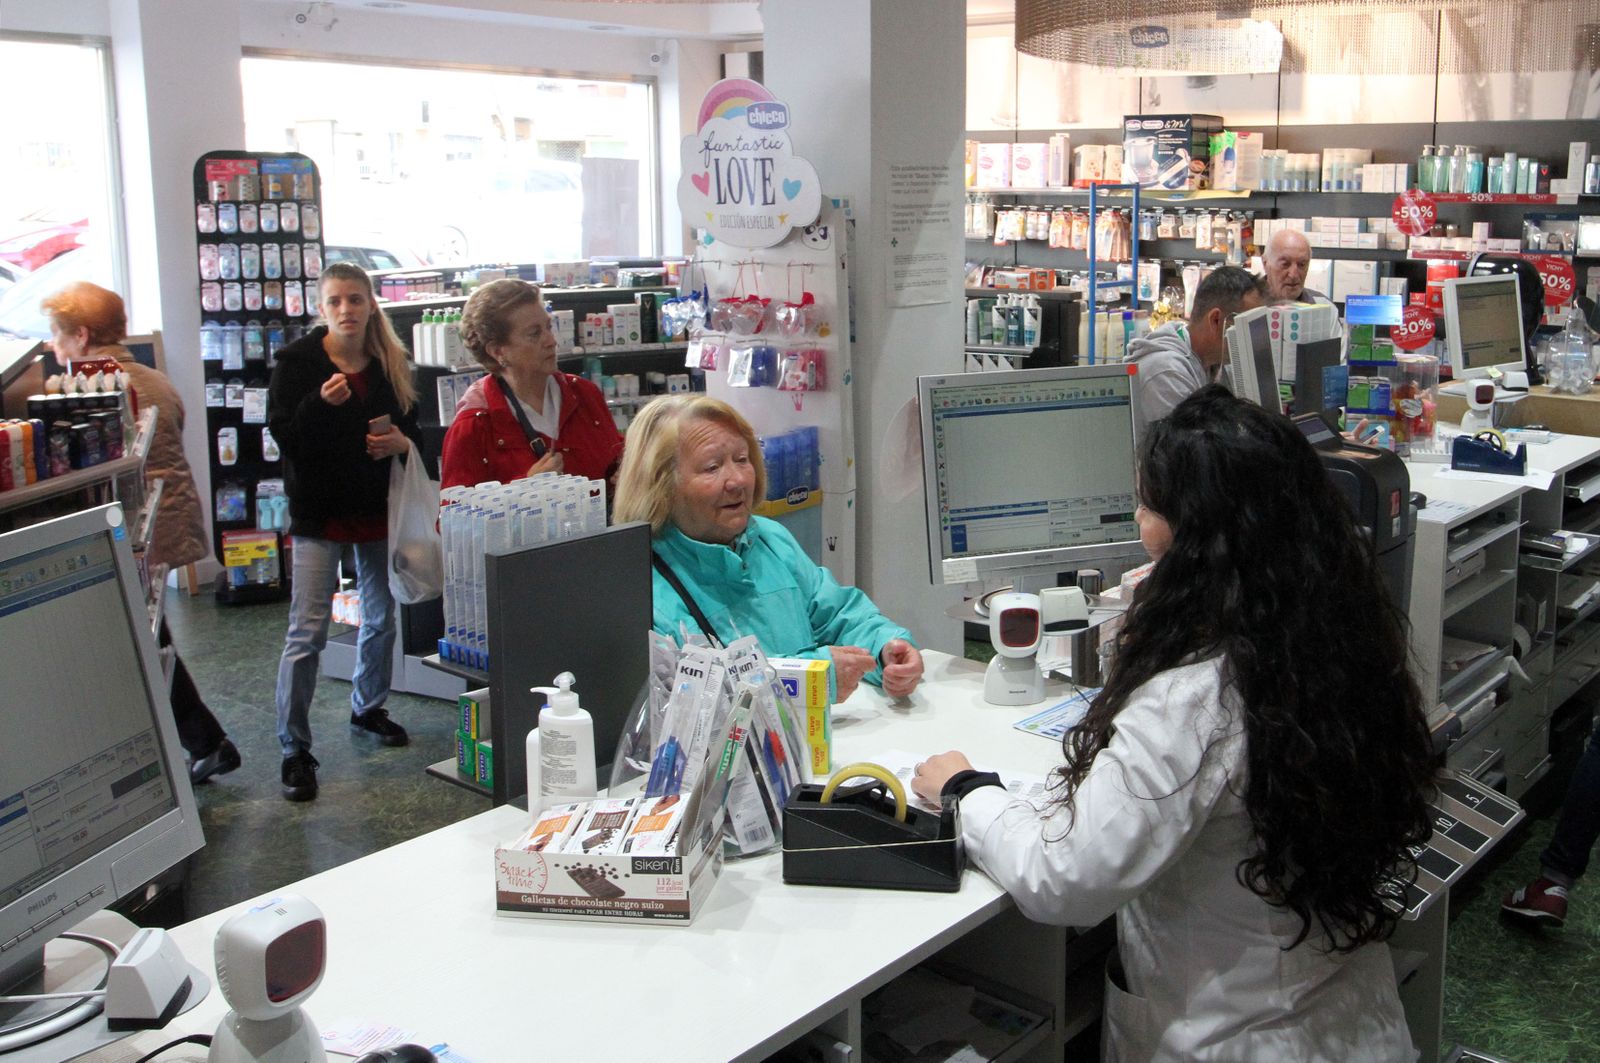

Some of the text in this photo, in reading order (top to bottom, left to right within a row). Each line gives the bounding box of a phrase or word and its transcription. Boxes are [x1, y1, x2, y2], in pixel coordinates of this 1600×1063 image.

[748, 107, 786, 125] chicco
[698, 131, 784, 168] fantastic
[714, 156, 776, 206] LOVE
[1467, 193, 1493, 203] -50%
[1394, 205, 1434, 219] -50%
[1545, 263, 1564, 272] VICHY
[1393, 318, 1432, 336] -50%
[680, 665, 704, 679] KIN
[728, 664, 738, 676] KI
[740, 661, 754, 673] KIN
[1465, 793, 1480, 804] 5
[1435, 816, 1453, 830] 10
[634, 858, 670, 871] siken
[27, 892, 58, 915] PHILIPS
[521, 894, 665, 910] Galletas de chocolate negro suizo
